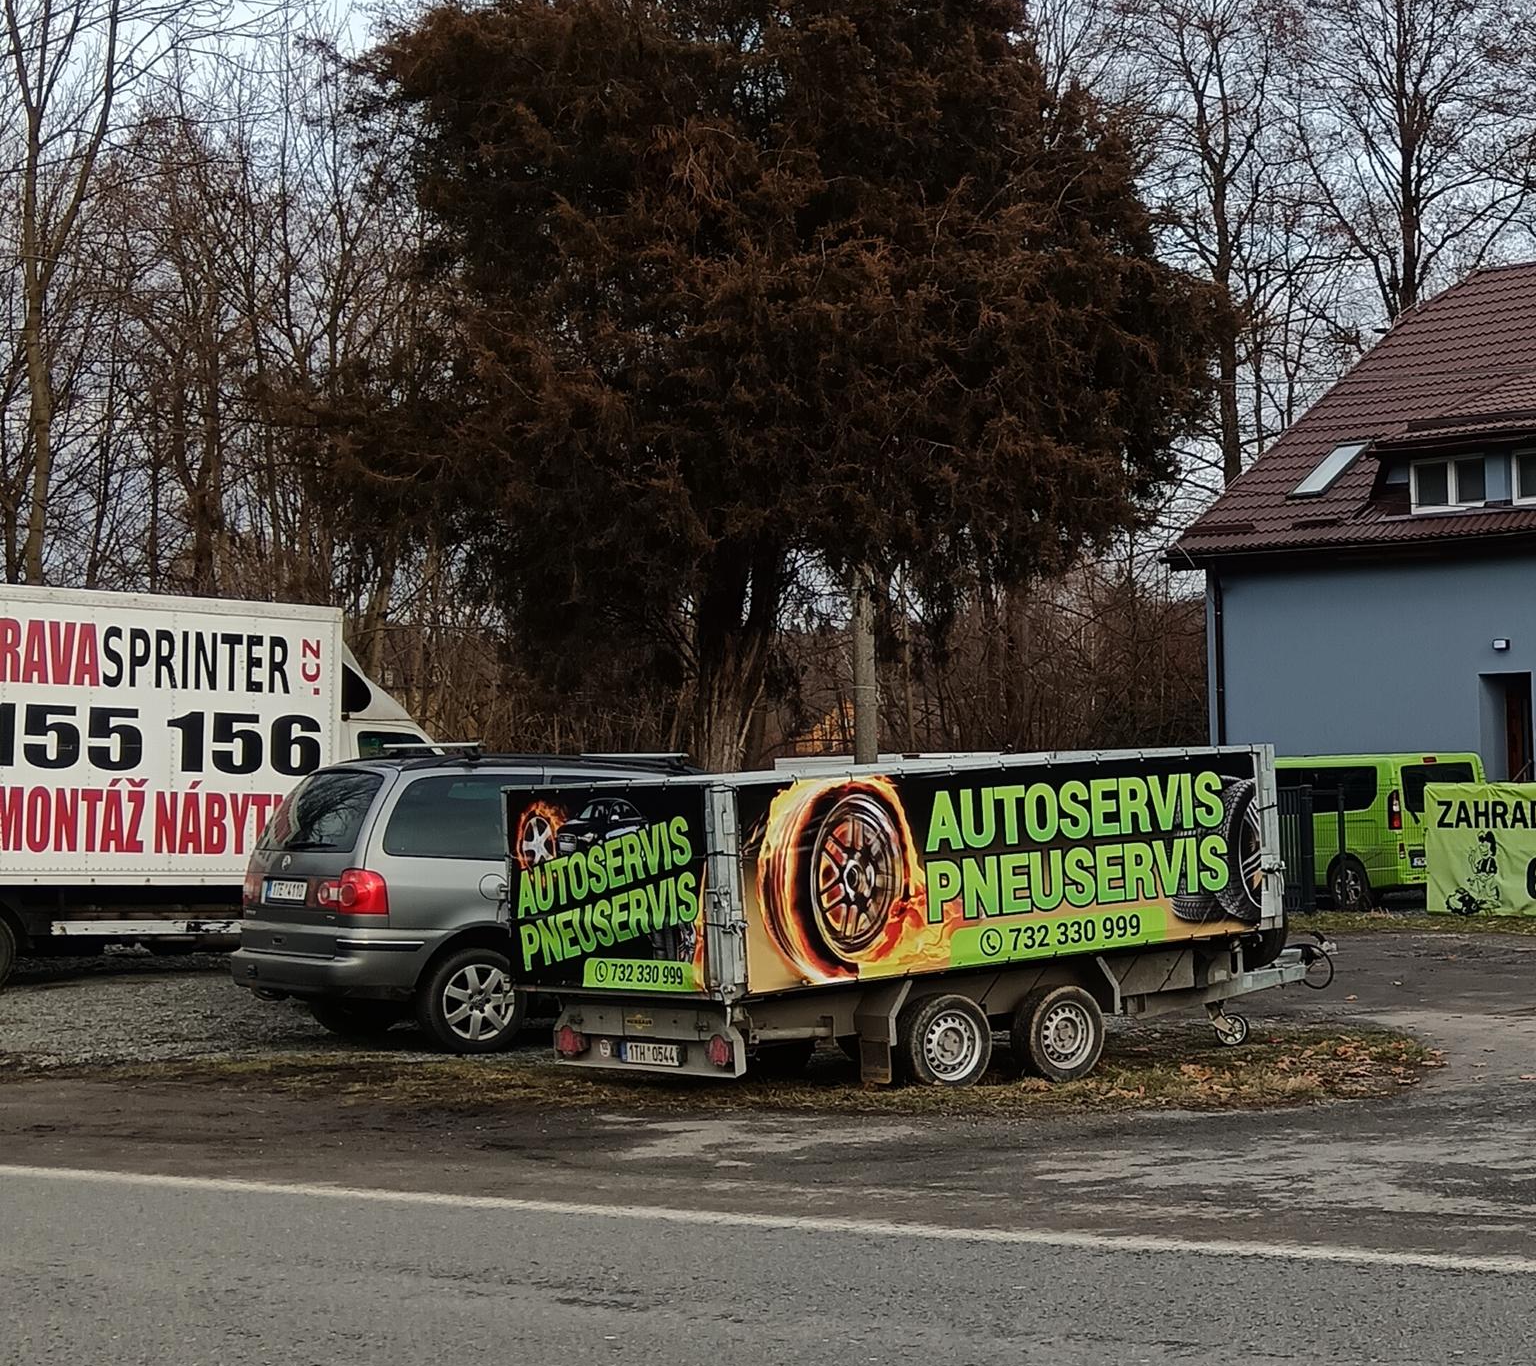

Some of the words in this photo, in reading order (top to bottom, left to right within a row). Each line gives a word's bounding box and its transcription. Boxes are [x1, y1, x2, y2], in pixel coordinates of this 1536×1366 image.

[166, 711, 322, 776] 156
[154, 780, 283, 854] NÁBYT
[925, 771, 1225, 853] AUTOSERVIS
[517, 816, 692, 919] AUTOSERVIS
[925, 835, 1230, 924] PNEUSERVIS
[519, 871, 698, 972] PNEUSERVIS
[1008, 924, 1050, 952] 732
[1056, 918, 1096, 946] 330
[1102, 913, 1141, 941] 999
[611, 963, 633, 983] 732
[637, 965, 659, 984] 330
[662, 966, 683, 985] 999
[629, 1044, 646, 1061] 1TH
[652, 1046, 675, 1063] 0544
